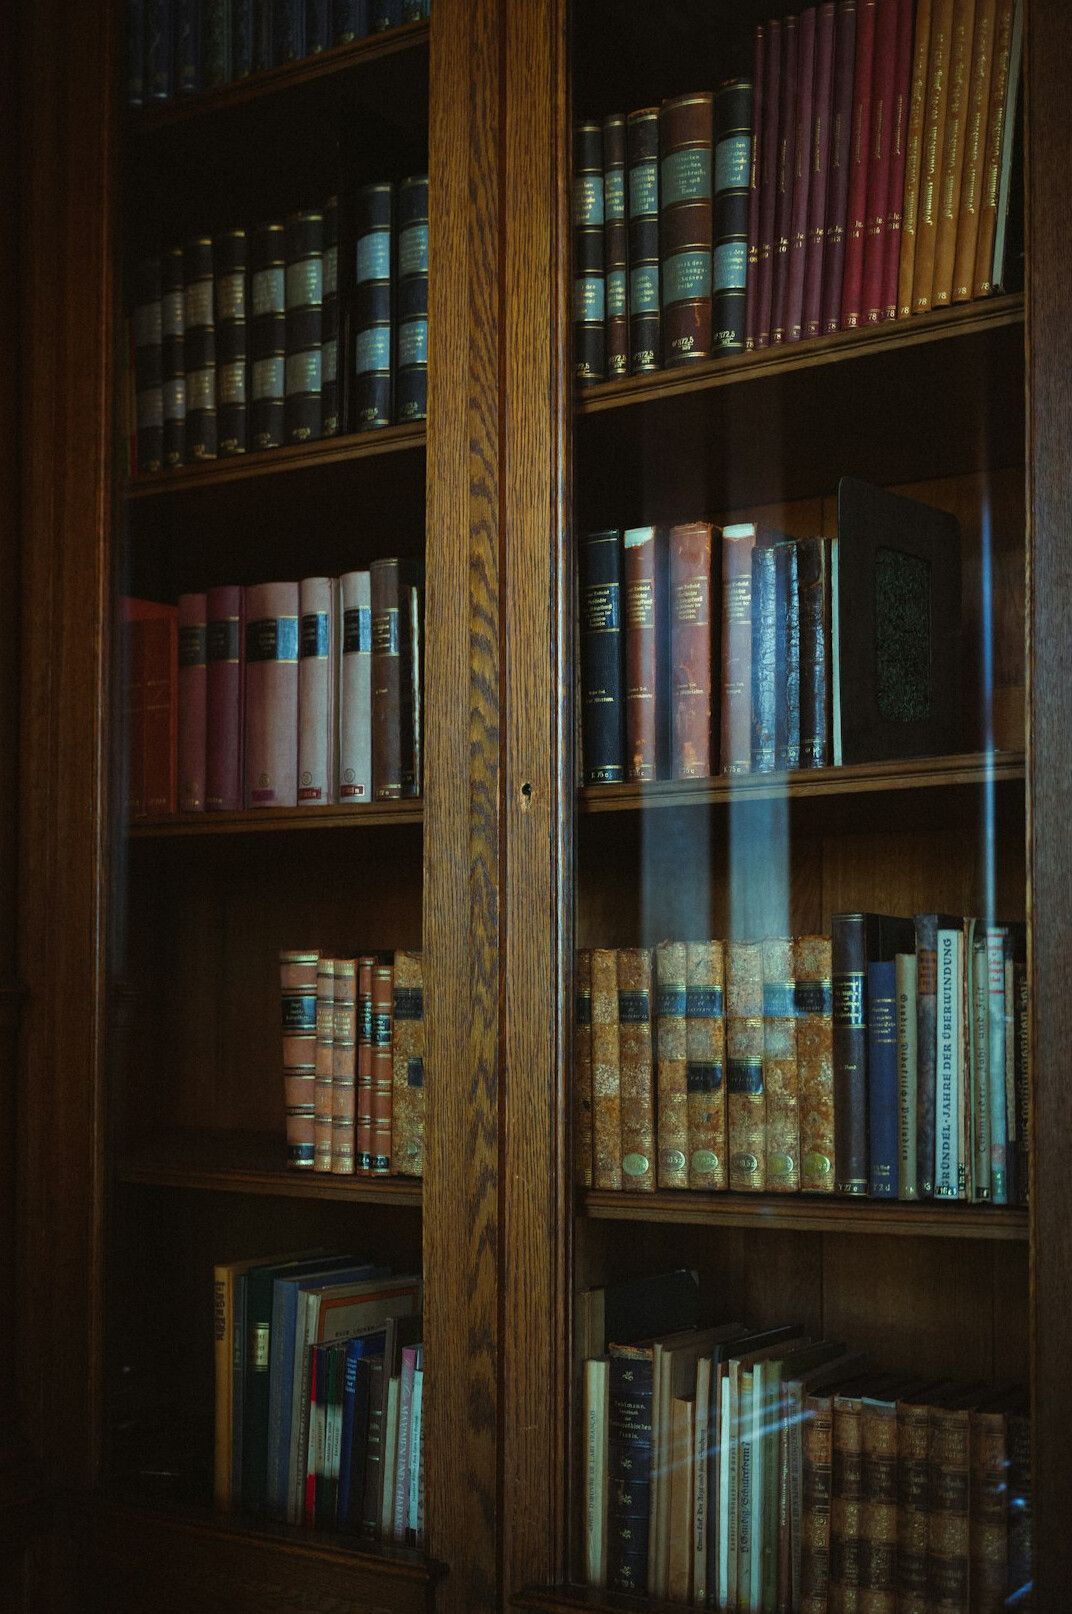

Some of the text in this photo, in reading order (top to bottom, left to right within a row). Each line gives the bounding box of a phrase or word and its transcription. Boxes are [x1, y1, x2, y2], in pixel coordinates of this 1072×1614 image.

[941, 937, 952, 1039] ÜBERWINDUNG
[942, 1044, 952, 1070] DER
[941, 1074, 951, 1118] JAHRE
